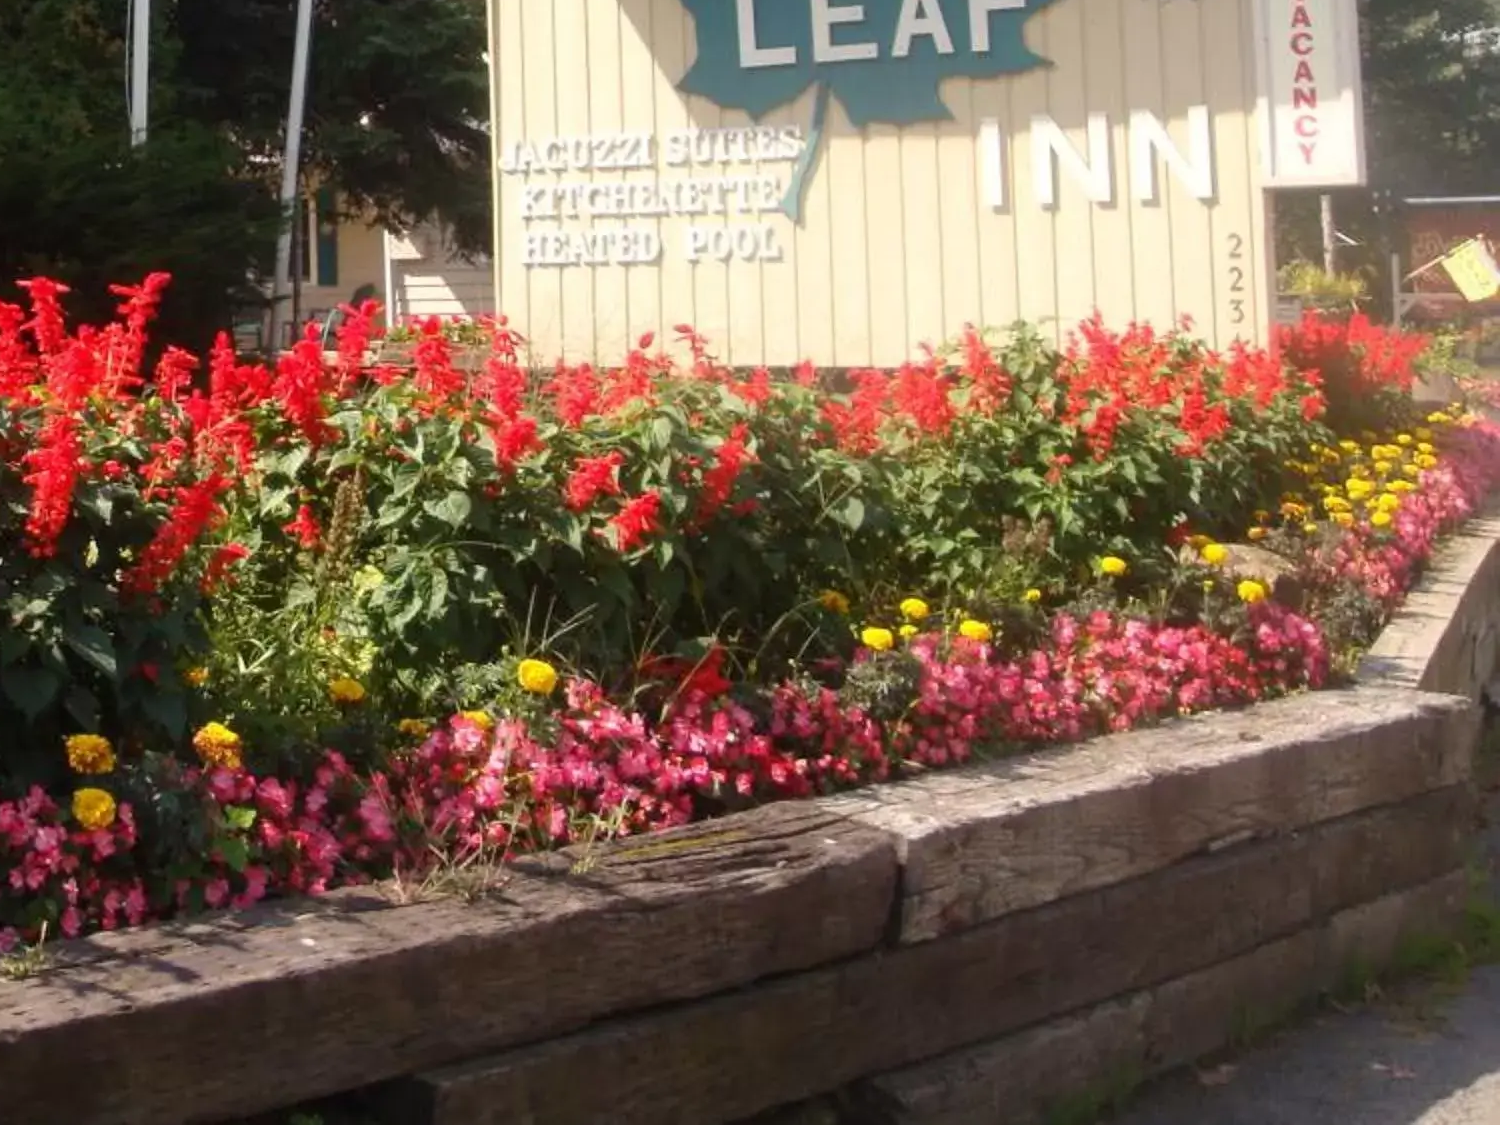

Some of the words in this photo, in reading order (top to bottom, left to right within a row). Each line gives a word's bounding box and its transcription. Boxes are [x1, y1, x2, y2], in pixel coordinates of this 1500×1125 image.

[499, 133, 654, 173] JACUZZI
[664, 125, 803, 166] SUITES
[980, 104, 1214, 208] INN
[520, 175, 784, 220] KITCHENETTE
[521, 227, 663, 267] HEATED
[684, 222, 785, 263] POOL
[1226, 232, 1246, 342] 223
